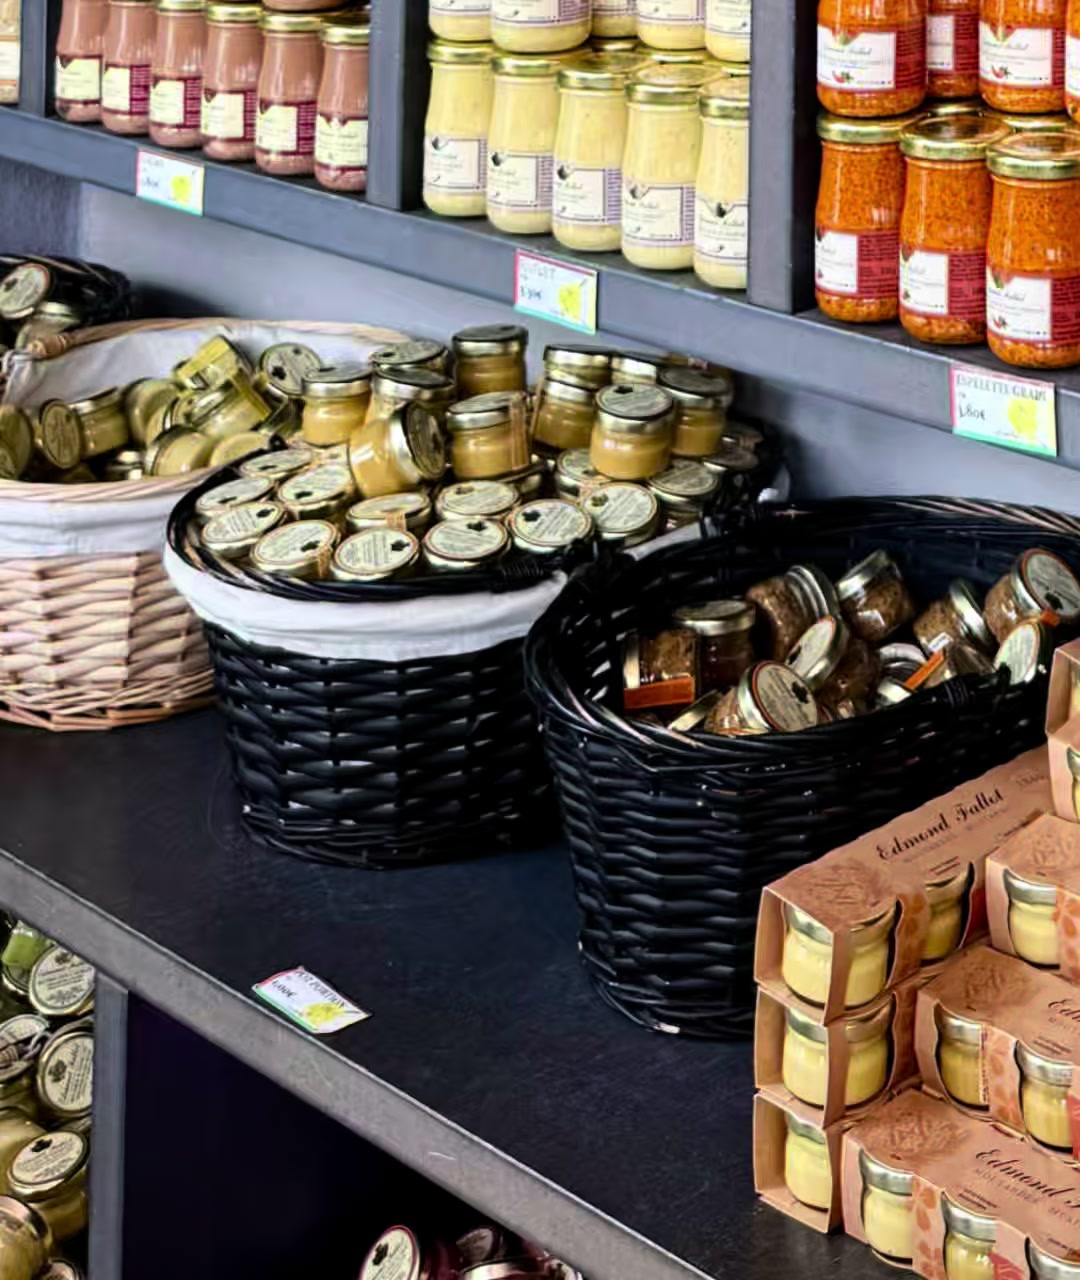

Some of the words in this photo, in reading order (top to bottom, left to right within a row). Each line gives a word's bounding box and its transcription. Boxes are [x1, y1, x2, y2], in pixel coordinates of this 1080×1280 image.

[875, 811, 953, 864] Edmond
[953, 785, 1006, 829] Fallot
[975, 1148, 1076, 1198] Edmond
